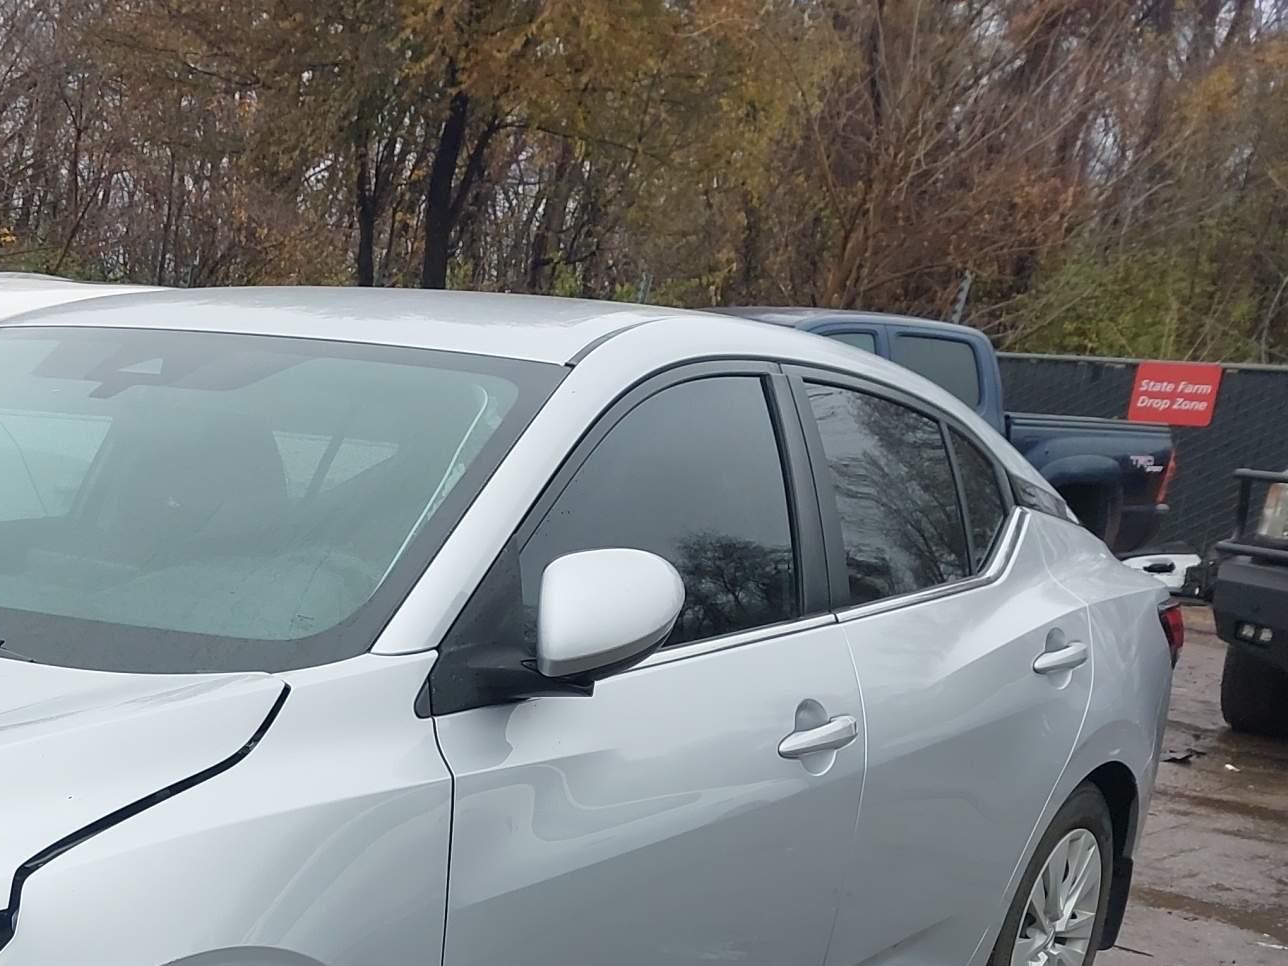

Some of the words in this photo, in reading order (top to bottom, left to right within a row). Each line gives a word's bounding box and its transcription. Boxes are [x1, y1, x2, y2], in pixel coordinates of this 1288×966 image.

[1140, 380, 1174, 393] State
[1177, 381, 1211, 394] Farm
[1137, 396, 1170, 411] Drop
[1172, 398, 1208, 410] Zone
